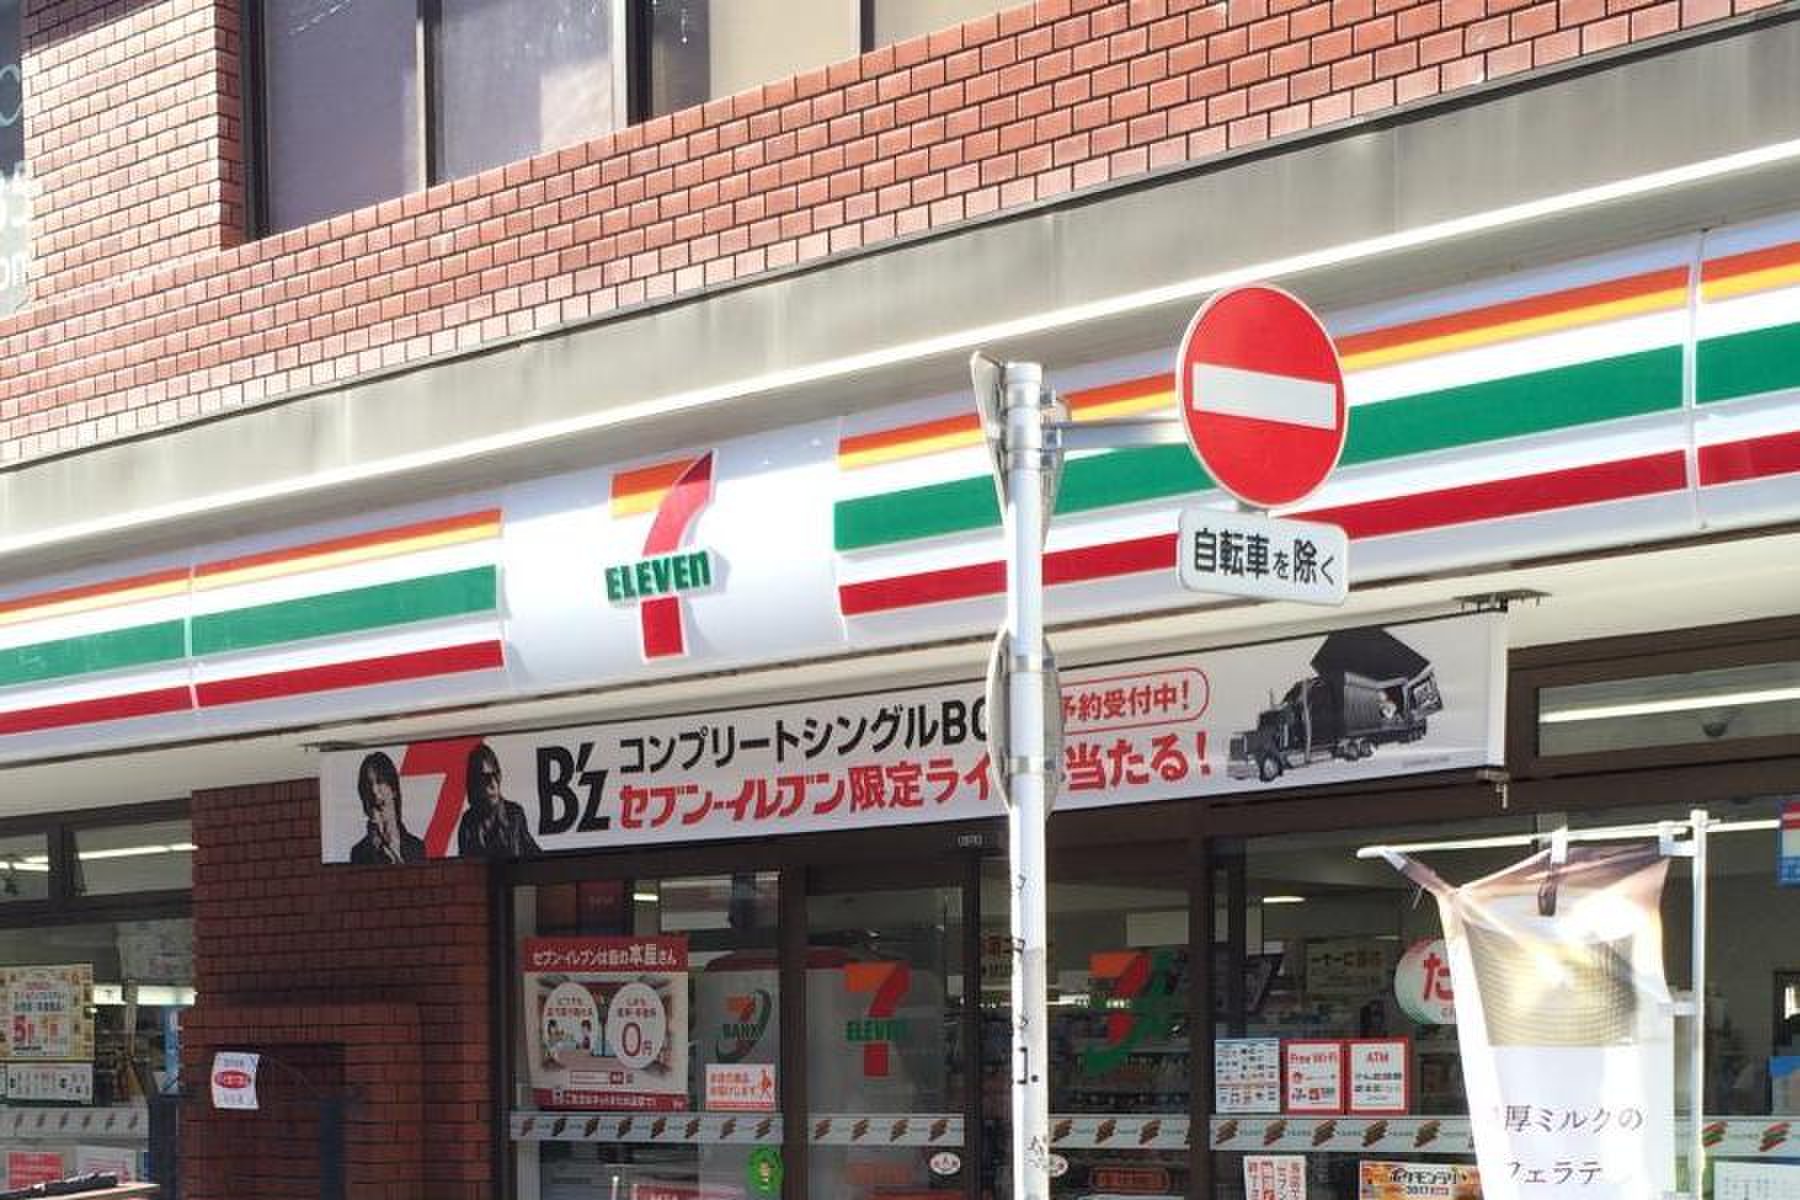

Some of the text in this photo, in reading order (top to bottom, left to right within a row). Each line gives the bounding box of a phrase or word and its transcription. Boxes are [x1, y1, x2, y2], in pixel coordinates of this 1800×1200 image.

[1194, 527, 1336, 586] 自転車を除く
[1504, 1103, 1644, 1133] 厚ミルクの
